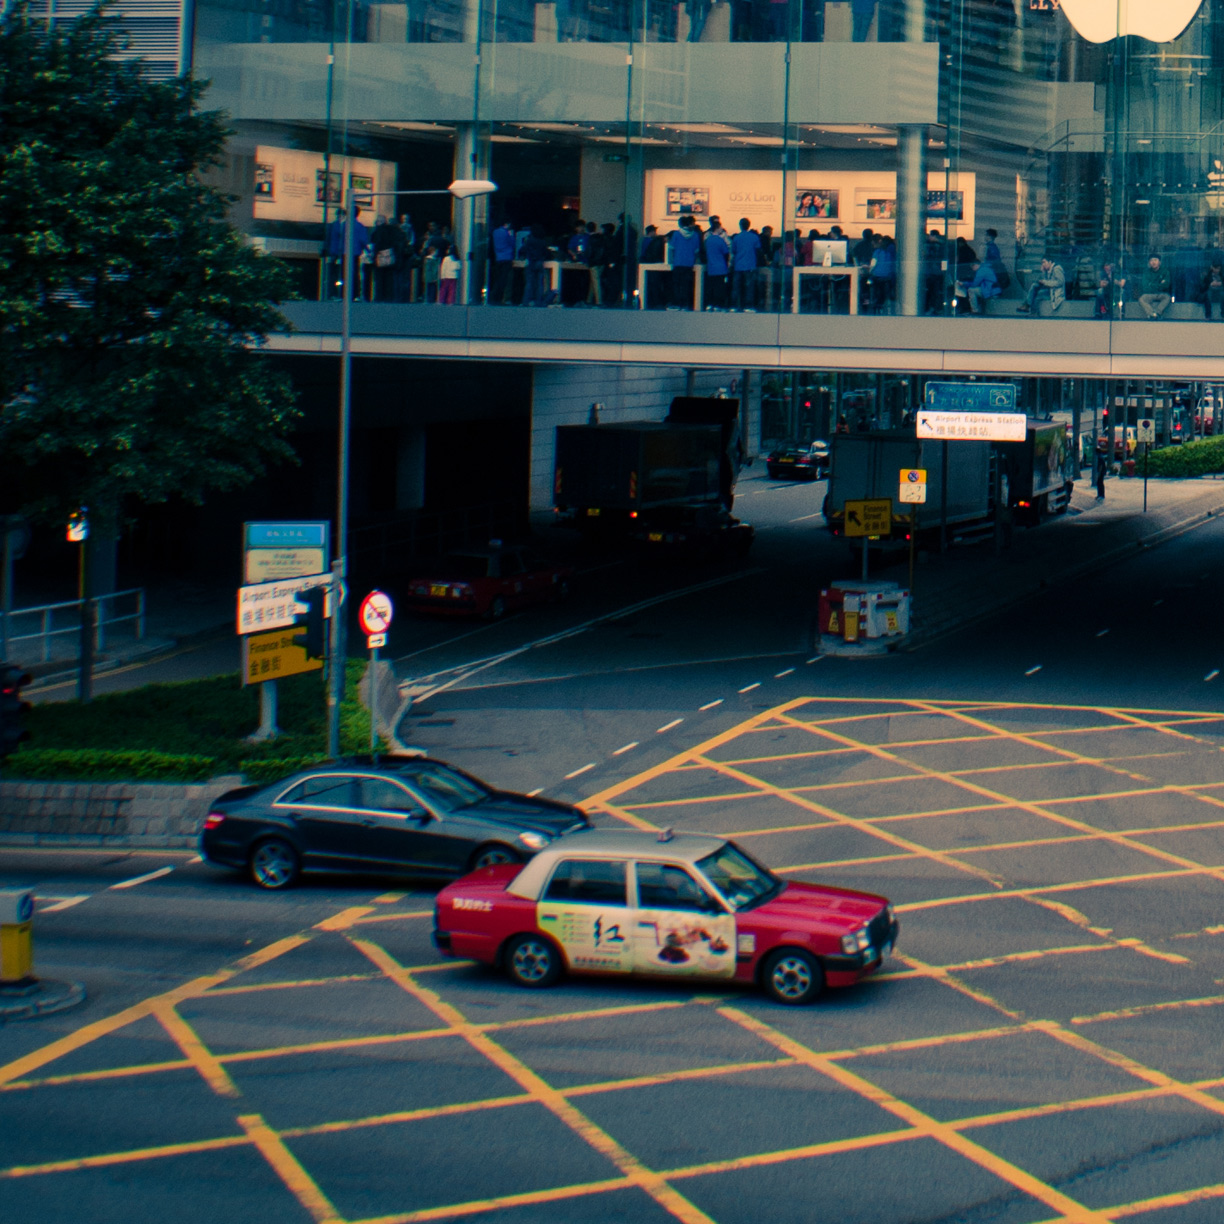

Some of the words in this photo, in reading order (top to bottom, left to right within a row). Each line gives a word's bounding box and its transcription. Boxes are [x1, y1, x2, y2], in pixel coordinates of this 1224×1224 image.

[754, 191, 776, 202] Lion
[935, 415, 961, 423] Airport
[964, 416, 993, 424] Express
[864, 512, 881, 520] Street
[242, 591, 270, 603] Airport
[271, 586, 303, 599] Express
[250, 639, 279, 654] Finance
